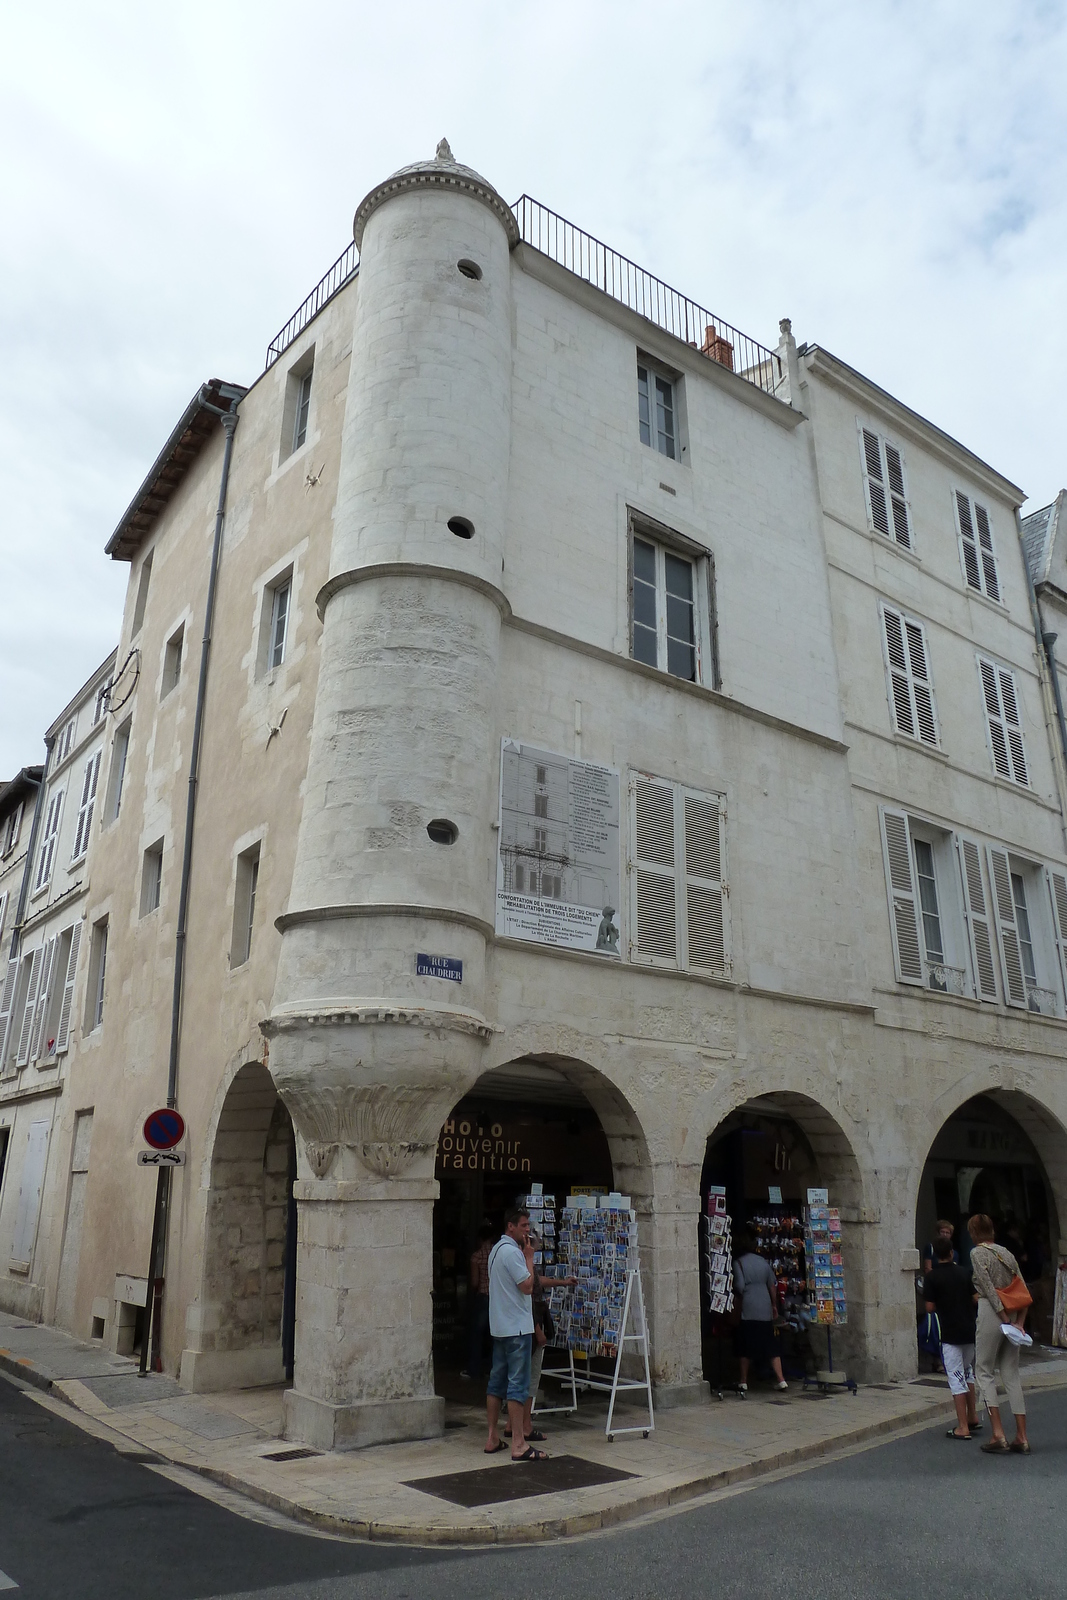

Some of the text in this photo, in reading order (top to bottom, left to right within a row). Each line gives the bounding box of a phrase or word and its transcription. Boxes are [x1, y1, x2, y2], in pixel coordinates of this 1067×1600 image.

[498, 894, 532, 905] CONFORTATION
[566, 912, 592, 922] LOGEMENTS
[432, 957, 448, 968] RUE
[418, 965, 462, 980] CHAUDRIER
[444, 1119, 503, 1138] HOO
[436, 1136, 520, 1154] ouvenir
[436, 1152, 532, 1172] radition
